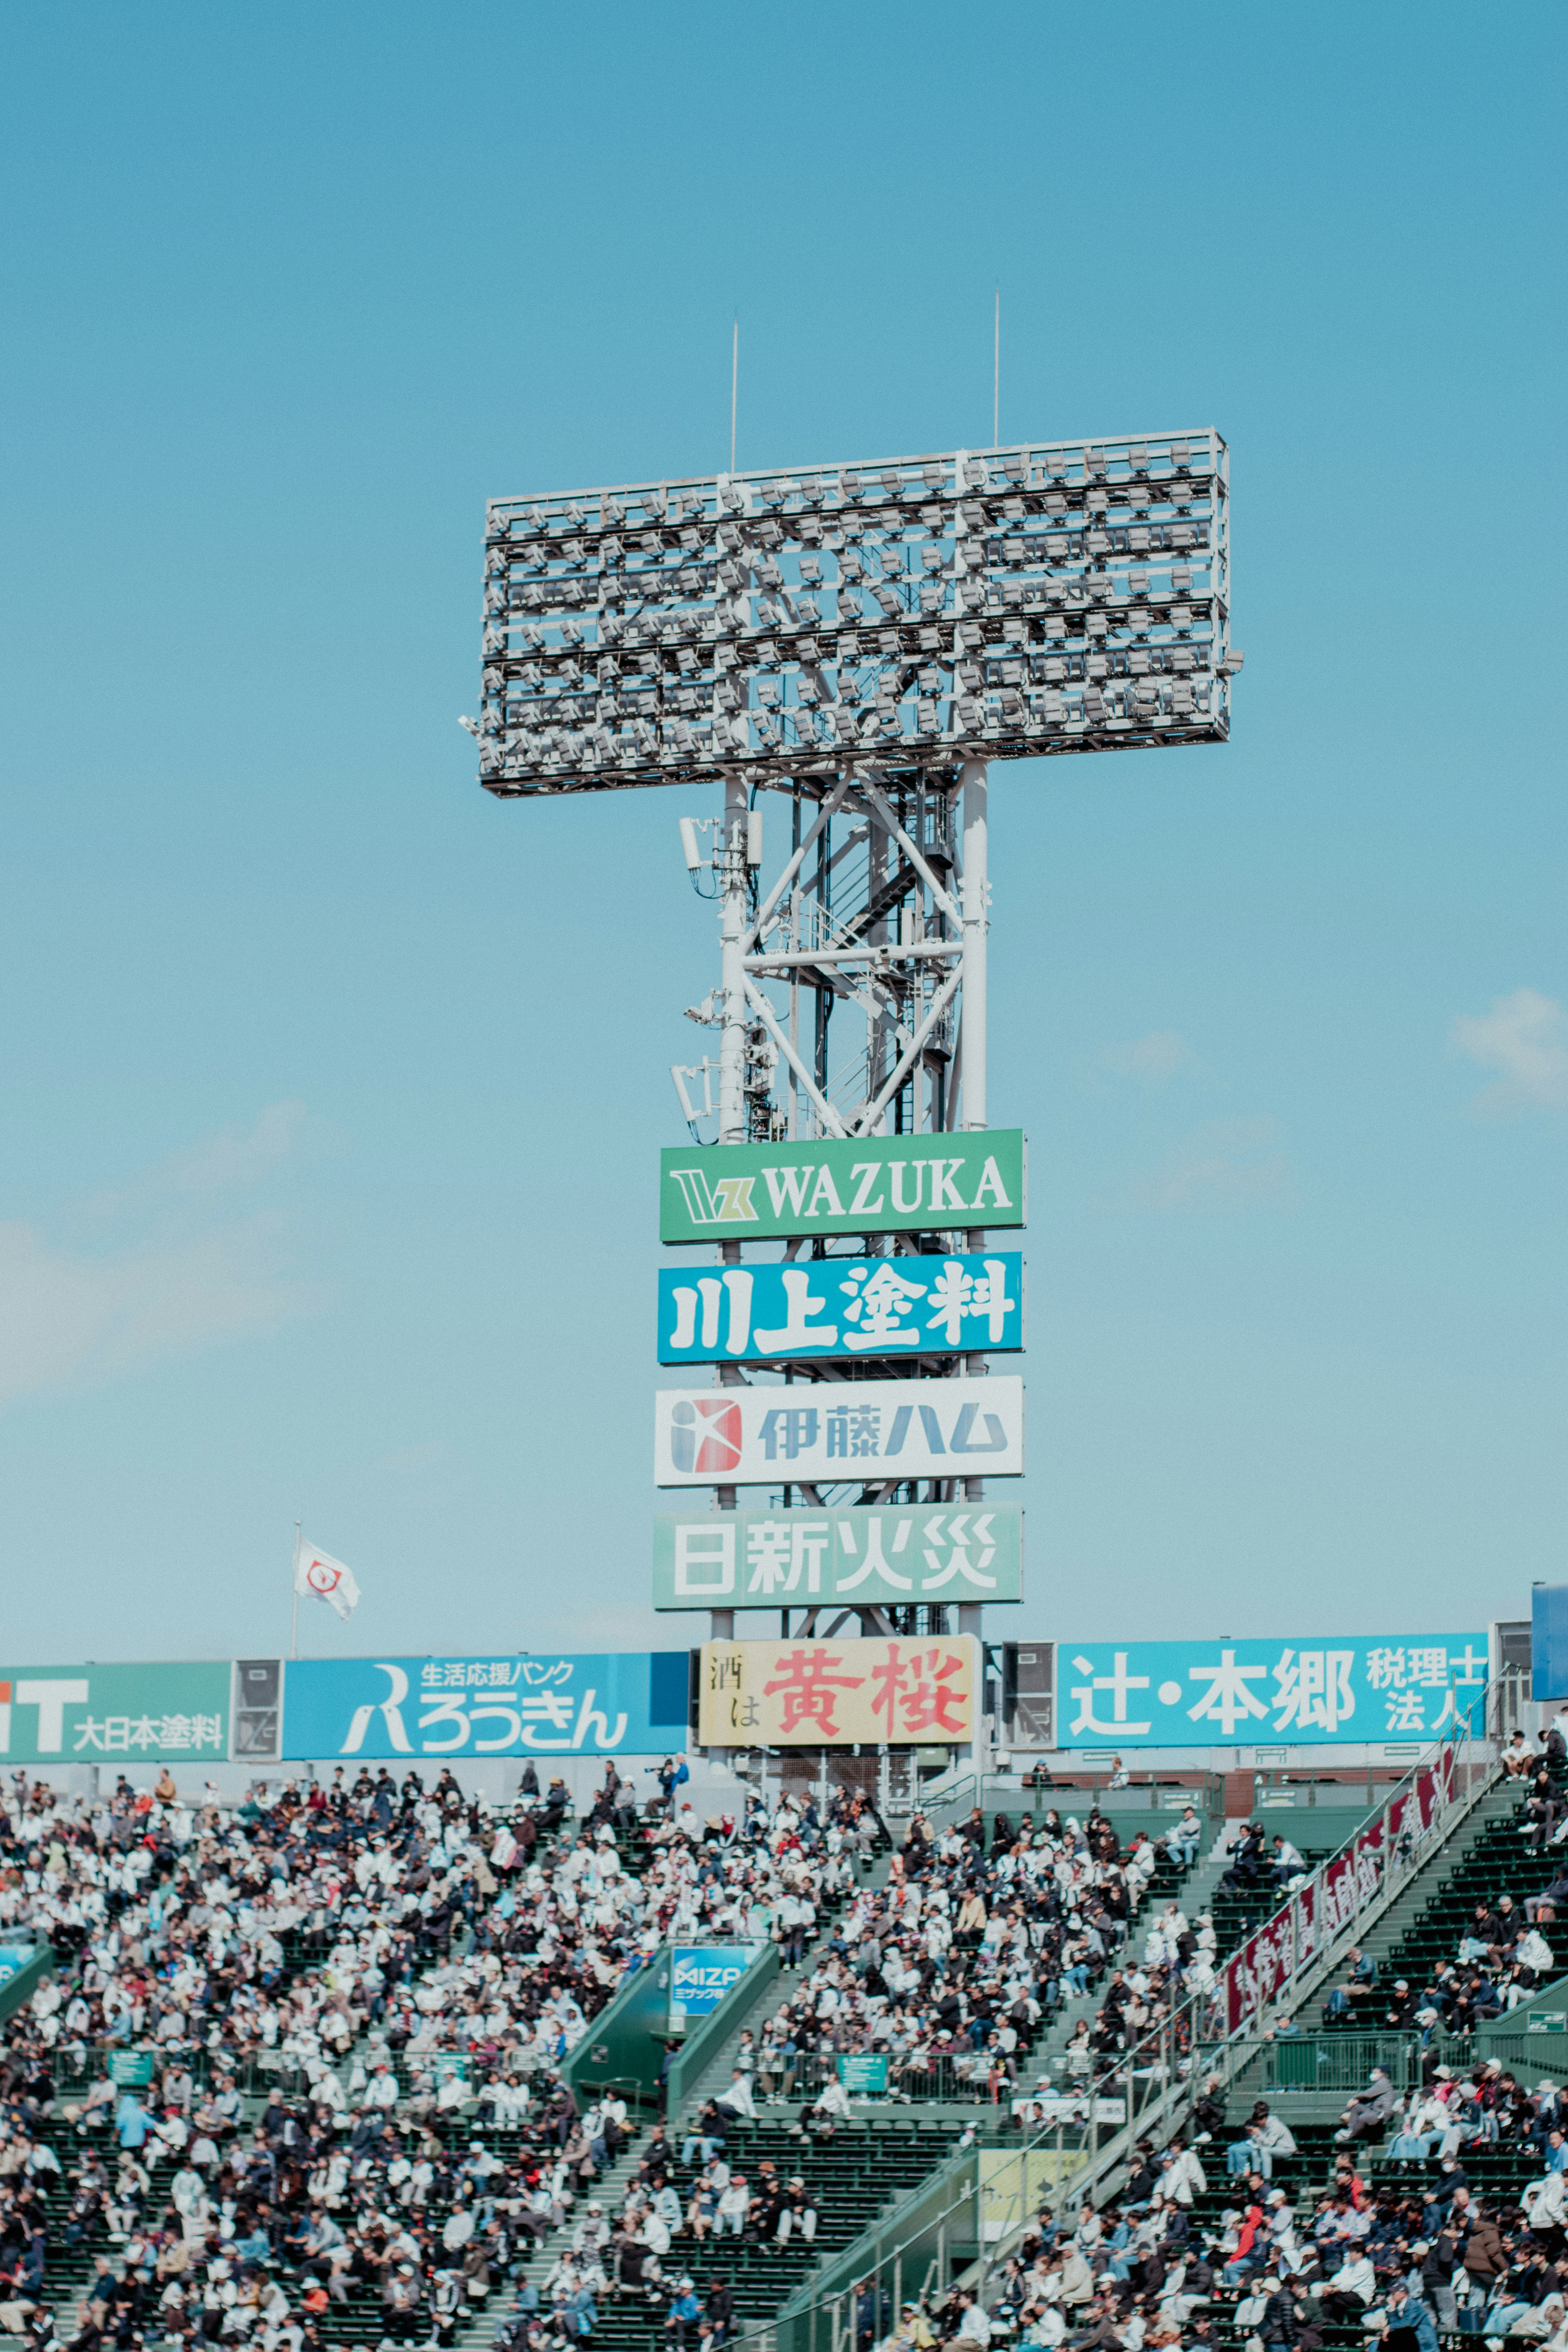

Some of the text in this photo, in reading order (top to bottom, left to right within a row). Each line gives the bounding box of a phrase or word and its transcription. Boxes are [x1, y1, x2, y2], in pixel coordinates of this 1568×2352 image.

[762, 1156, 1012, 1218] WAZUKA
[669, 1259, 1015, 1355] 川上塗料
[757, 1403, 1008, 1460] 伊藤ハム
[675, 1514, 996, 1595] 日新火災
[421, 1661, 573, 1686] 生活応援バンク
[763, 1642, 968, 1739] 黄桜
[1069, 1649, 1355, 1737] 辻・本郷
[1367, 1645, 1488, 1689] 税理士
[73, 1714, 223, 1752] 大日本塗料
[418, 1689, 628, 1752] ろうきん
[1384, 1690, 1468, 1731] 法人
